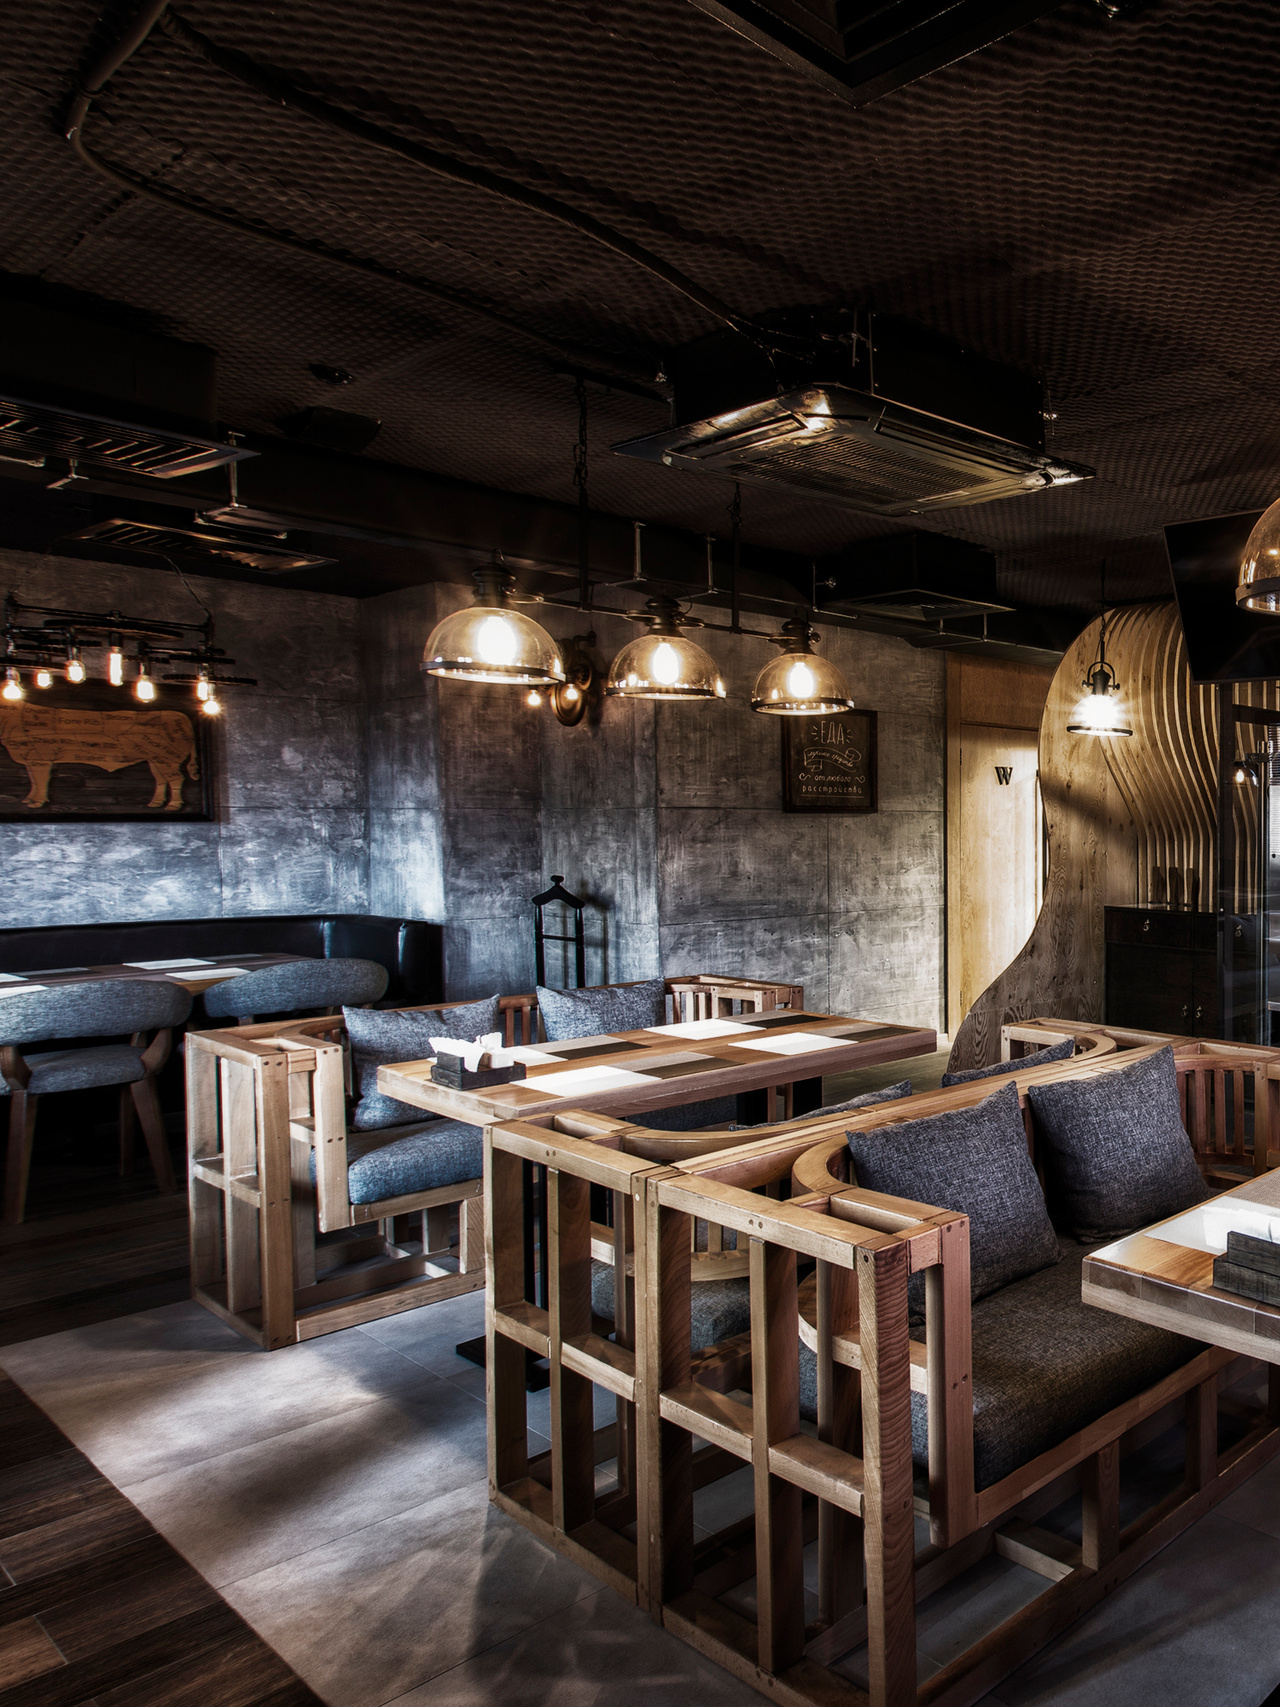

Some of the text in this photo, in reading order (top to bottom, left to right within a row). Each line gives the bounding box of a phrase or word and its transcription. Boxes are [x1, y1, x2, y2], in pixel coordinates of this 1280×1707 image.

[58, 717, 100, 726] Fore Rib
[820, 720, 845, 745] ЕДА
[826, 774, 852, 783] любого
[994, 766, 1014, 786] W
[802, 784, 862, 794] расстройства
